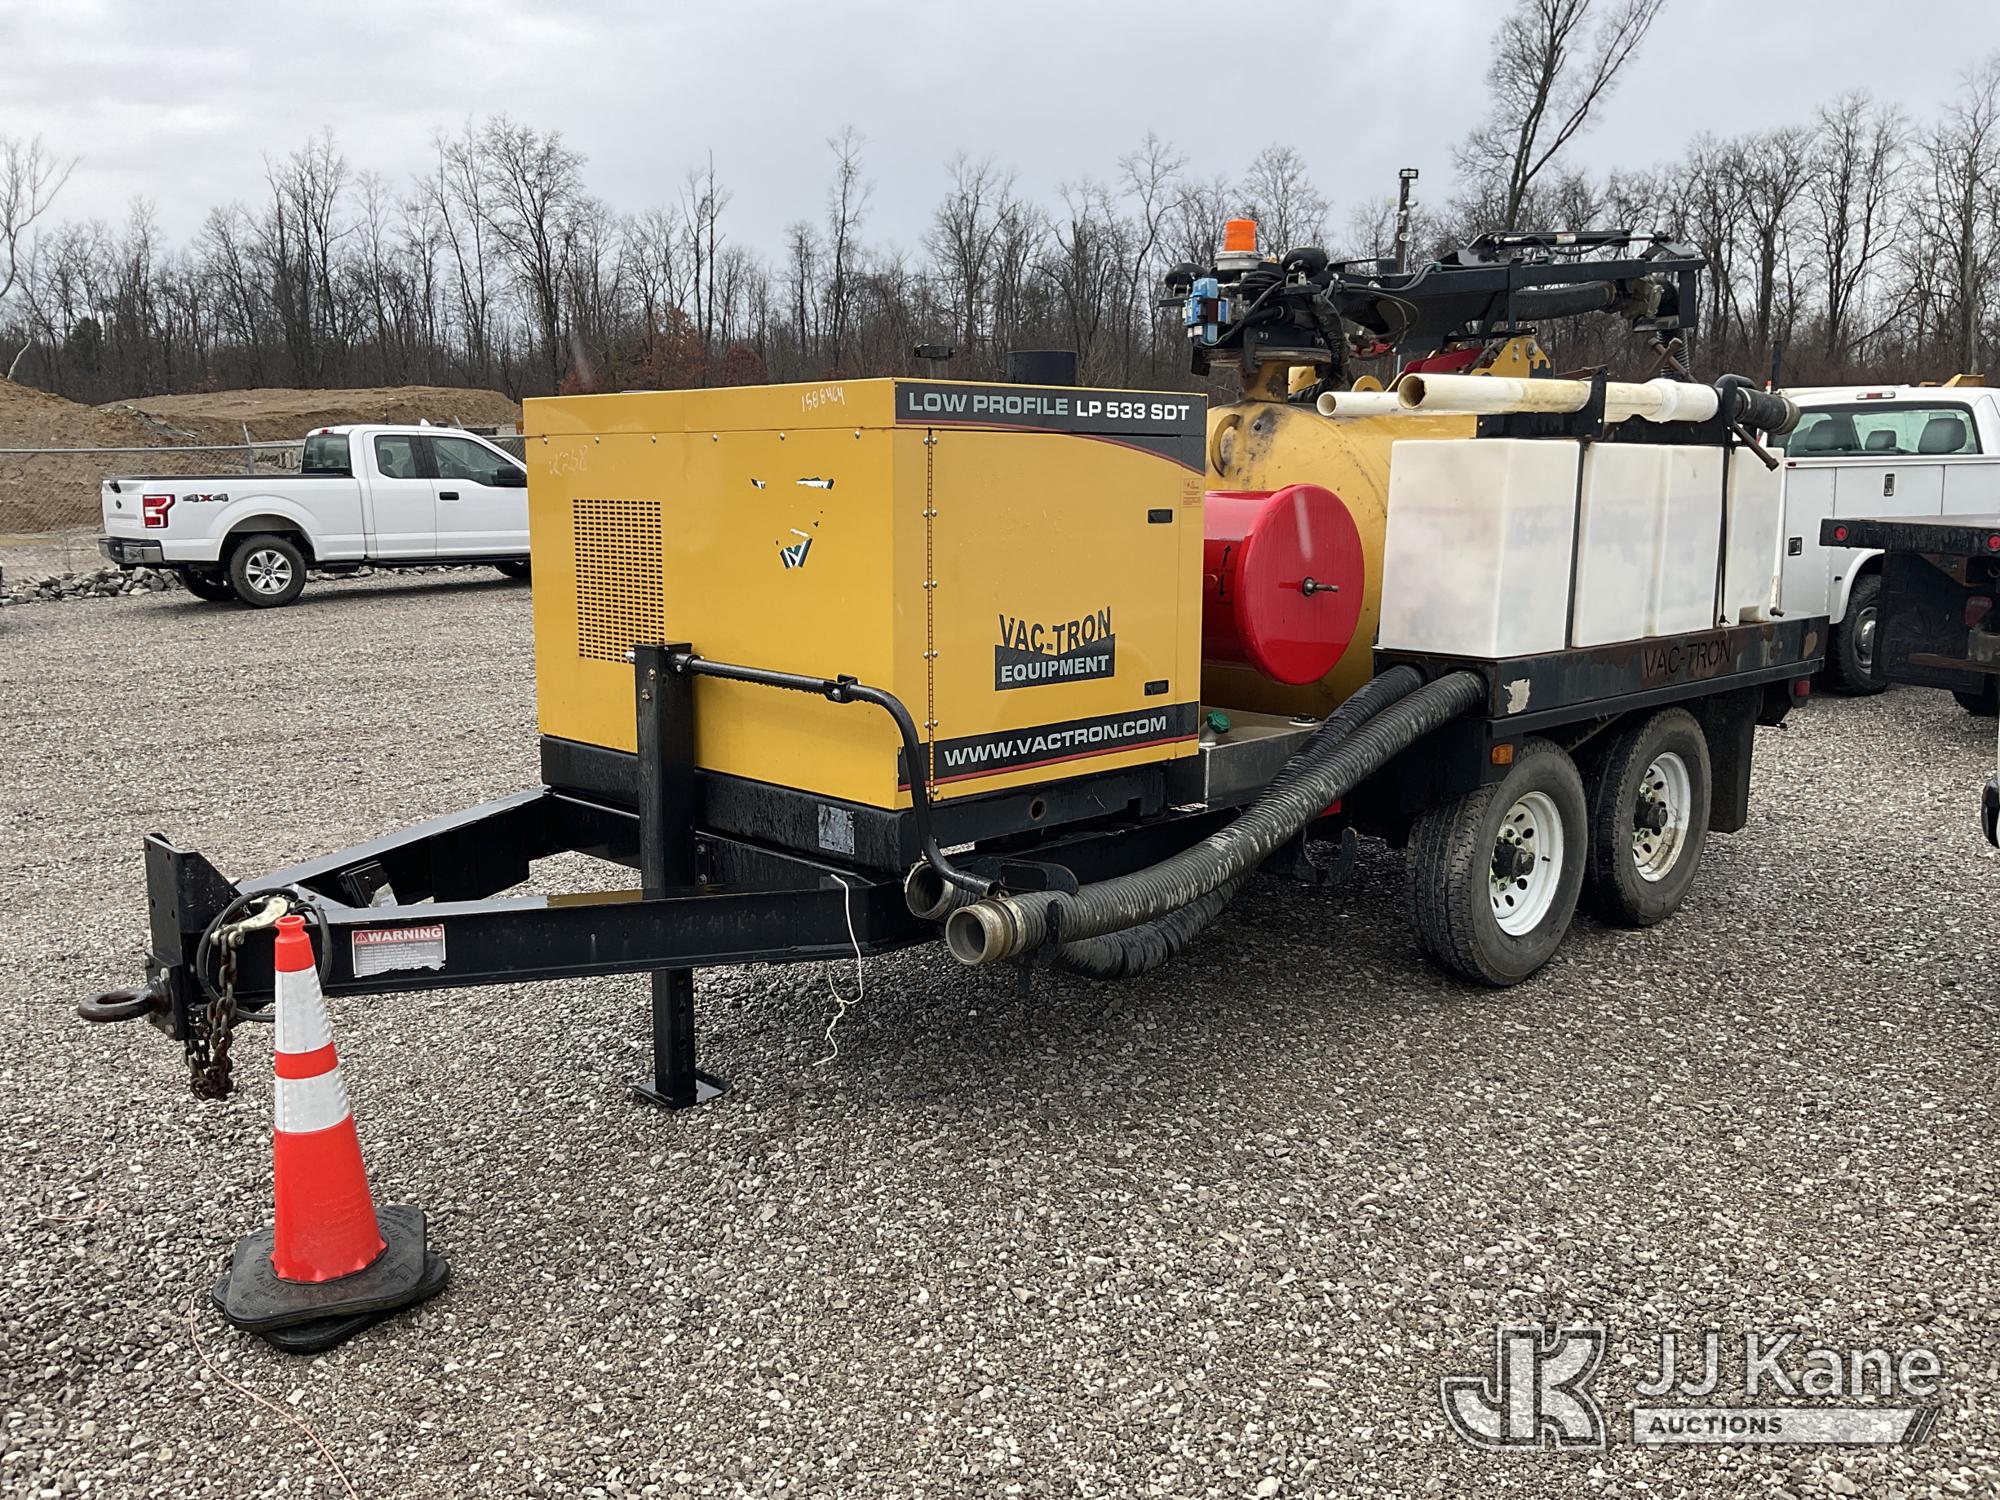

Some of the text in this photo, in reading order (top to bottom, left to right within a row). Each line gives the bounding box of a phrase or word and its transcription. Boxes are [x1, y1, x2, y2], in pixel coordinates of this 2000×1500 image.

[909, 392, 1190, 421] LOW PROFILE LP 533 SDT
[998, 606, 1112, 654] VAC-TRON
[1000, 654, 1110, 683] EQUIPMENT
[1643, 637, 1735, 679] VAC-TRON
[944, 715, 1167, 767] WWW.VACTRON.COM
[367, 927, 442, 943] WARNING
